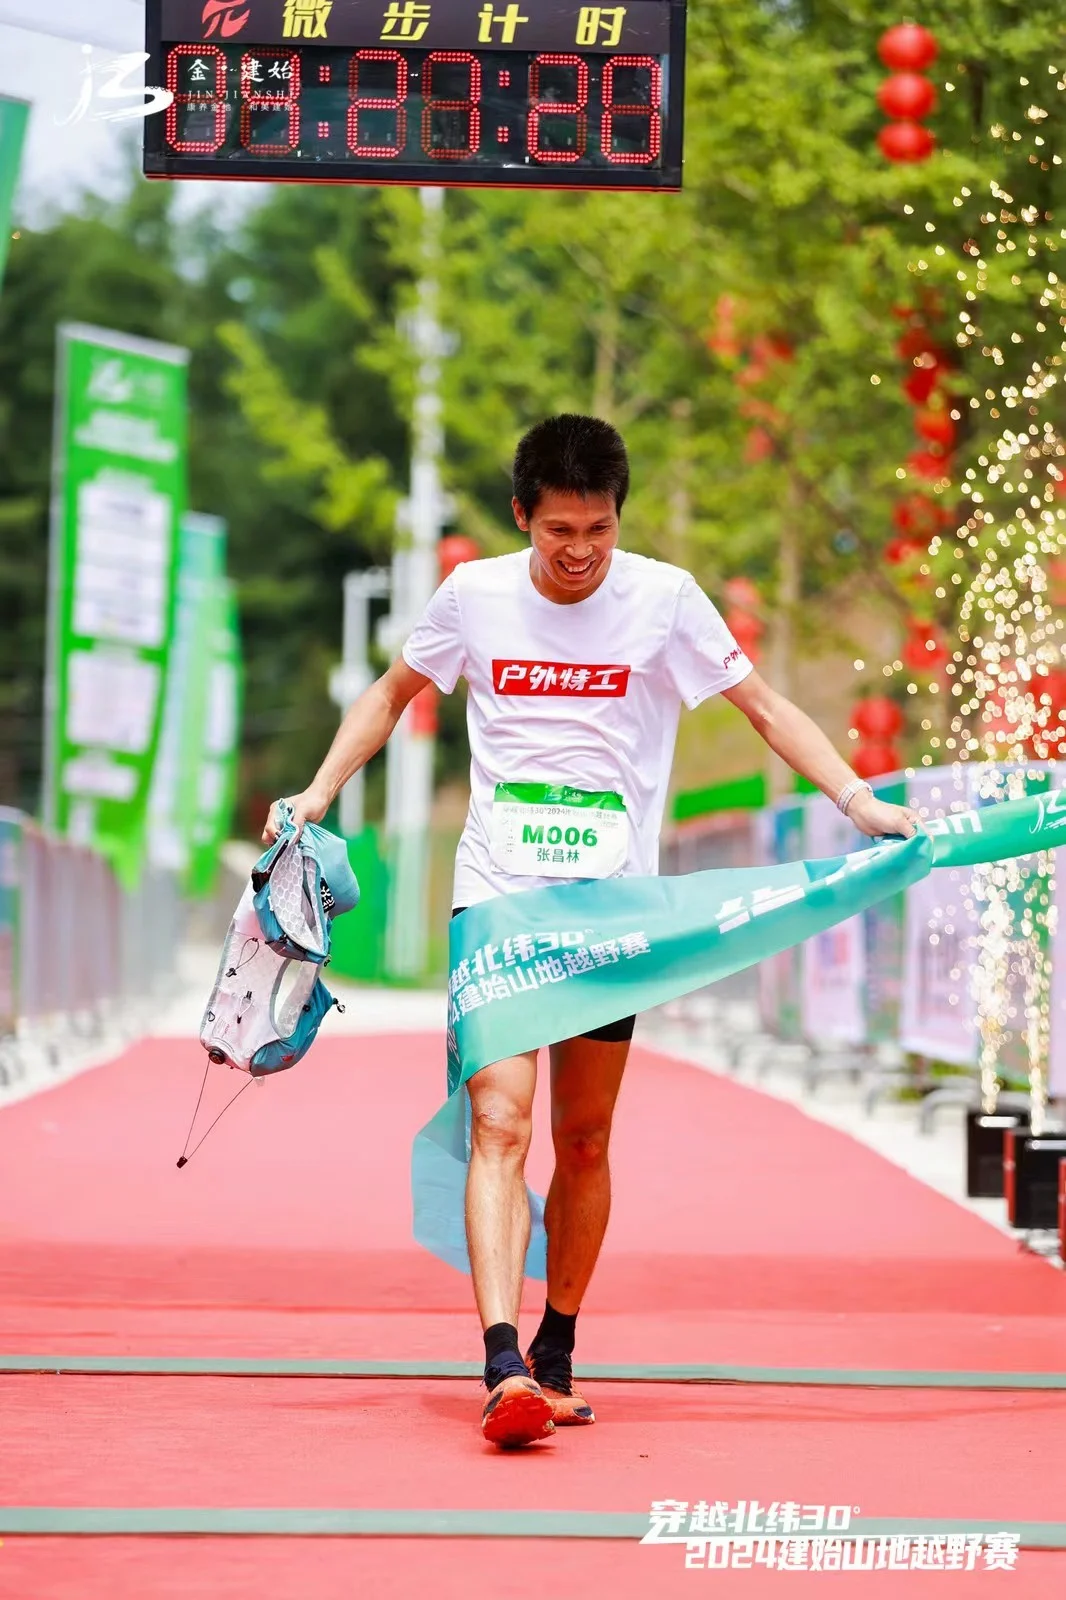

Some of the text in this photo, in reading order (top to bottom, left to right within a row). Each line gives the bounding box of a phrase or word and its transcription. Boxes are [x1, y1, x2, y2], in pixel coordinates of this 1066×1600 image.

[282, 0, 627, 47] 微步计时
[723, 647, 742, 670] 户外
[498, 664, 625, 692] 户外特工
[521, 824, 598, 847] M006
[536, 847, 580, 864] 张昌林
